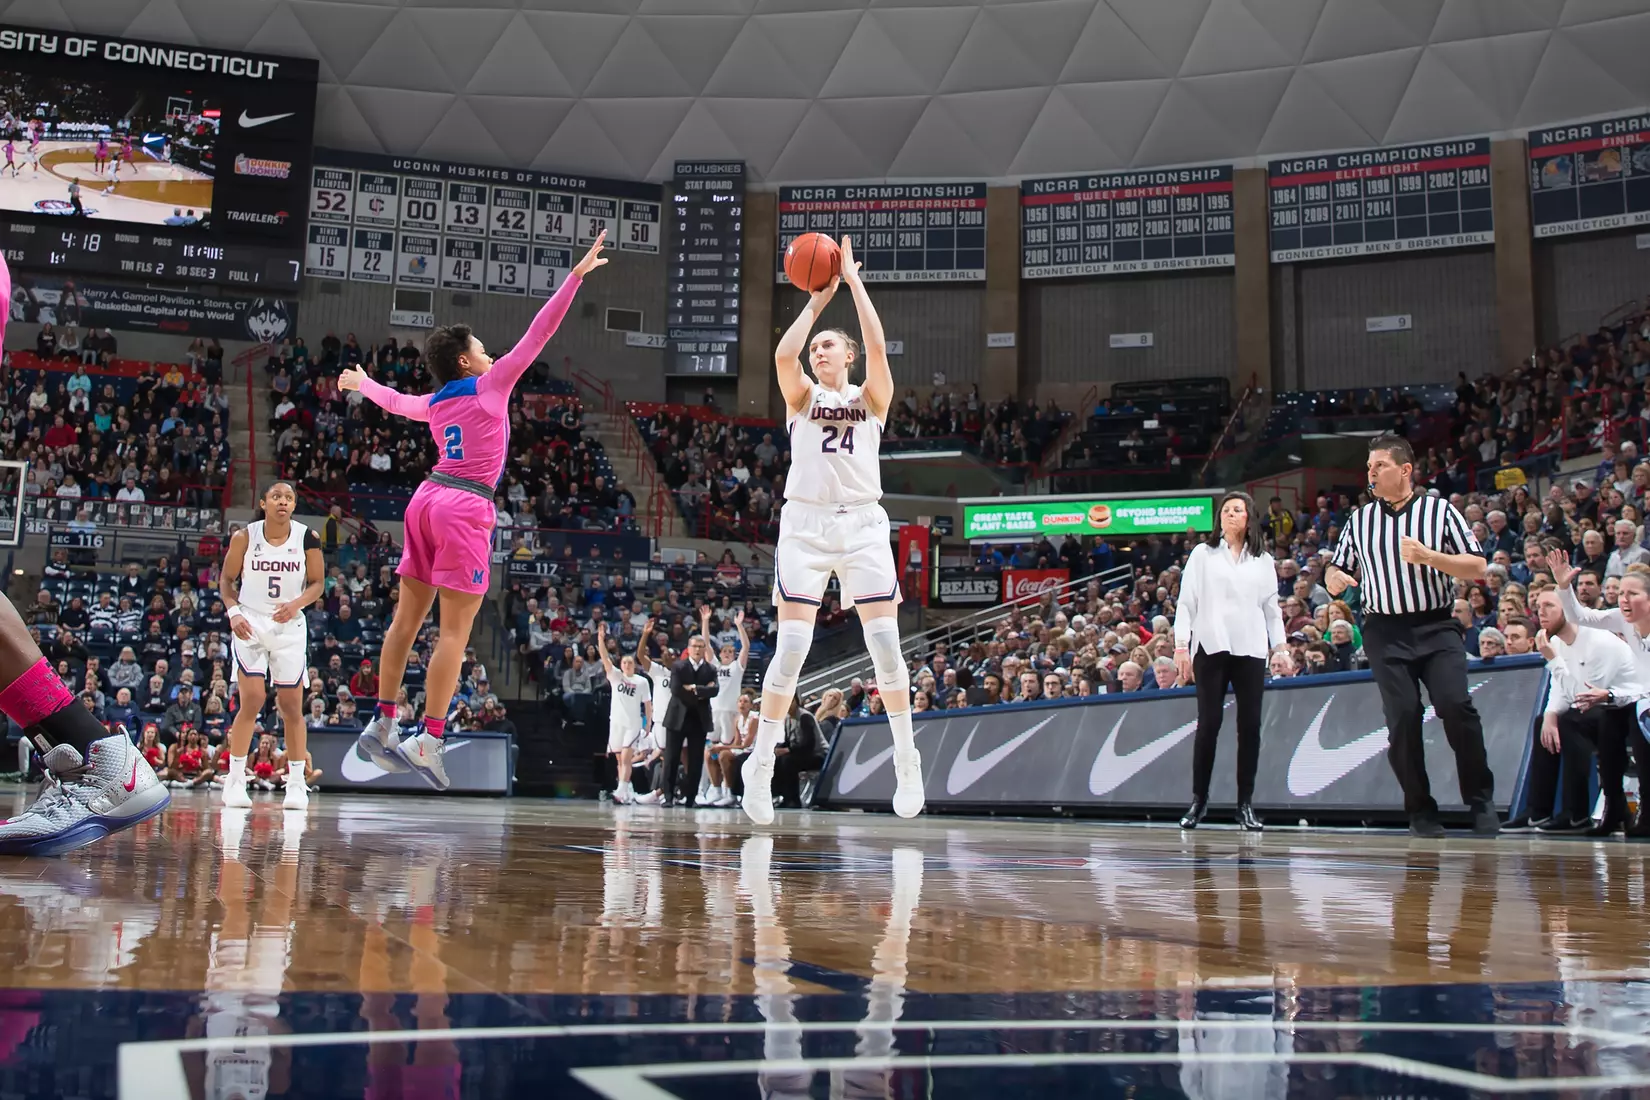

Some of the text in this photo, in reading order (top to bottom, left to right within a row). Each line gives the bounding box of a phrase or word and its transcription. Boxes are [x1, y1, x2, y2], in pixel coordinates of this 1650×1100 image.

[0, 30, 279, 79] SITY OF CONNECTICUT
[1542, 126, 1592, 144] NCAA
[1601, 134, 1643, 147] FINAL
[1281, 142, 1476, 173] NCAA CHAMPIONSHIP
[250, 167, 288, 178] DONUTS
[393, 160, 587, 188] UCONN HUSKIES OF HONOR
[677, 164, 741, 173] GO HUSKIES
[1335, 162, 1420, 180] ELITE EIGHT
[685, 180, 733, 190] STAT BOARD
[1034, 169, 1220, 193] NCAA CHAMPIONSHIP
[1273, 168, 1487, 204] 1964 1990 1995 1999 2002 2004
[792, 185, 974, 200] NCAA CHAMPIONSHIP
[1074, 186, 1180, 201] SWEET SIXTEEN
[317, 190, 346, 212] 52
[790, 199, 976, 211] TOURNAMENT APPEARANCES
[1026, 194, 1230, 222] 1956 1964 1976 1990 1991 1994 1995
[226, 211, 279, 224] TRAVELERS
[407, 200, 437, 221] 00
[453, 204, 479, 225] 13
[730, 207, 741, 216] 23
[1273, 200, 1391, 226] 2006 2009 2011 2014
[496, 209, 526, 230] 42
[545, 213, 563, 234] 34
[680, 222, 741, 231] 0 0
[781, 212, 952, 228] 2000 2002 2003 2004 2005 2006
[1540, 217, 1628, 235] CONNECTICUT
[10, 224, 36, 234] BONUS
[631, 222, 649, 242] 50
[1026, 215, 1231, 243] 1996 1999 2002 2003 2004 2006
[62, 232, 101, 252] 4:18
[115, 233, 172, 247] BONUS POSS
[869, 232, 921, 247] 2014 2016
[1277, 245, 1360, 261] CONNECTICUT
[1407, 233, 1488, 249] BASKETBALL
[8, 250, 25, 261] FLS
[320, 247, 335, 267] 15
[363, 251, 382, 272] 22
[1025, 245, 1108, 264] 2009 2011 2014
[121, 260, 249, 282] TM FLS 2 30 SEC 3 FULL
[288, 260, 300, 282] 7
[453, 259, 472, 281] 42
[732, 268, 739, 277] 2
[1027, 256, 1229, 276] CONNECTICUT BASKETBALL
[498, 264, 516, 285] 13
[547, 268, 555, 288] 3
[905, 270, 979, 280] BASKETBALL
[677, 283, 738, 292] 2 2
[83, 288, 247, 310] Harry A. Gampel Pavilion Storrs, CT
[676, 299, 683, 307] 2
[94, 300, 235, 321] Basketball Capital of the World
[411, 314, 433, 325] 216
[647, 336, 667, 346] 217
[677, 342, 727, 352] TIME OF DAY
[1140, 334, 1148, 344] 8
[691, 355, 725, 372] 7:17
[811, 407, 867, 422] UCONN
[443, 424, 464, 460] 2
[821, 425, 855, 454] 24
[973, 511, 1033, 522] GREAT TASTE
[1043, 513, 1084, 525] DUNKIN'
[1116, 507, 1156, 517] BEYOND
[1133, 515, 1187, 526] SANDWICH
[51, 534, 103, 547] SEC 116
[251, 560, 300, 572] UCONN
[510, 562, 558, 575] SEC 117
[472, 568, 484, 584] M
[268, 576, 281, 598] 5
[940, 580, 998, 595] BEAR'S
[617, 683, 636, 696] ONE
